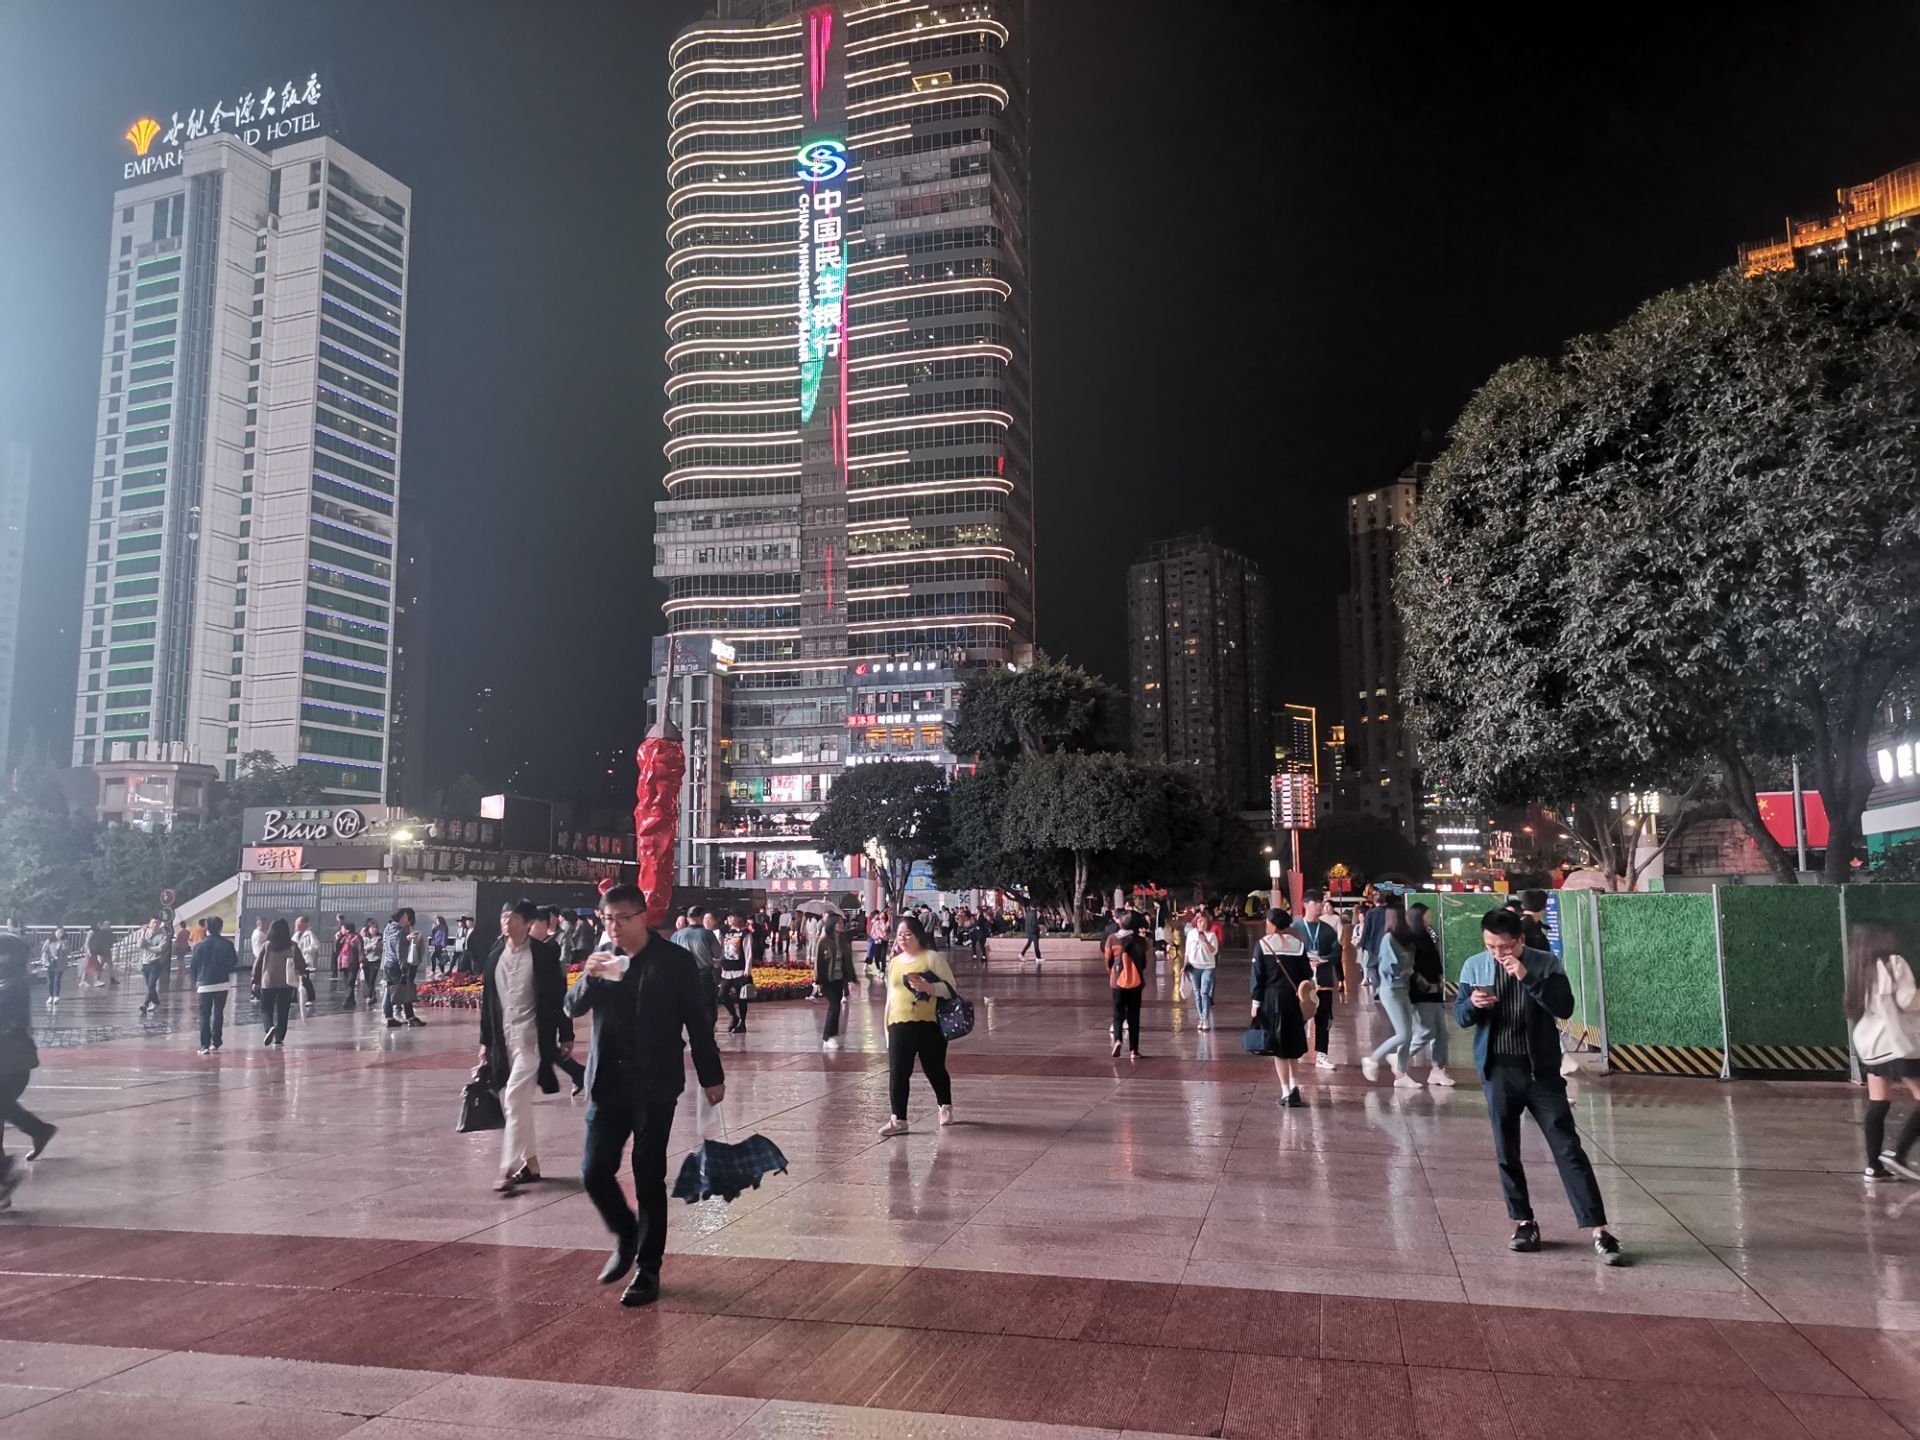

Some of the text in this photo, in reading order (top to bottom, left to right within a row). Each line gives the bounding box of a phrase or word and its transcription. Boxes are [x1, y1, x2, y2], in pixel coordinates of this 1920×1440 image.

[267, 112, 320, 141] HOTEL
[799, 194, 809, 362] CHINA MINSHENG BANK
[813, 189, 842, 358] 中国民生银行
[262, 810, 328, 840] Bravo
